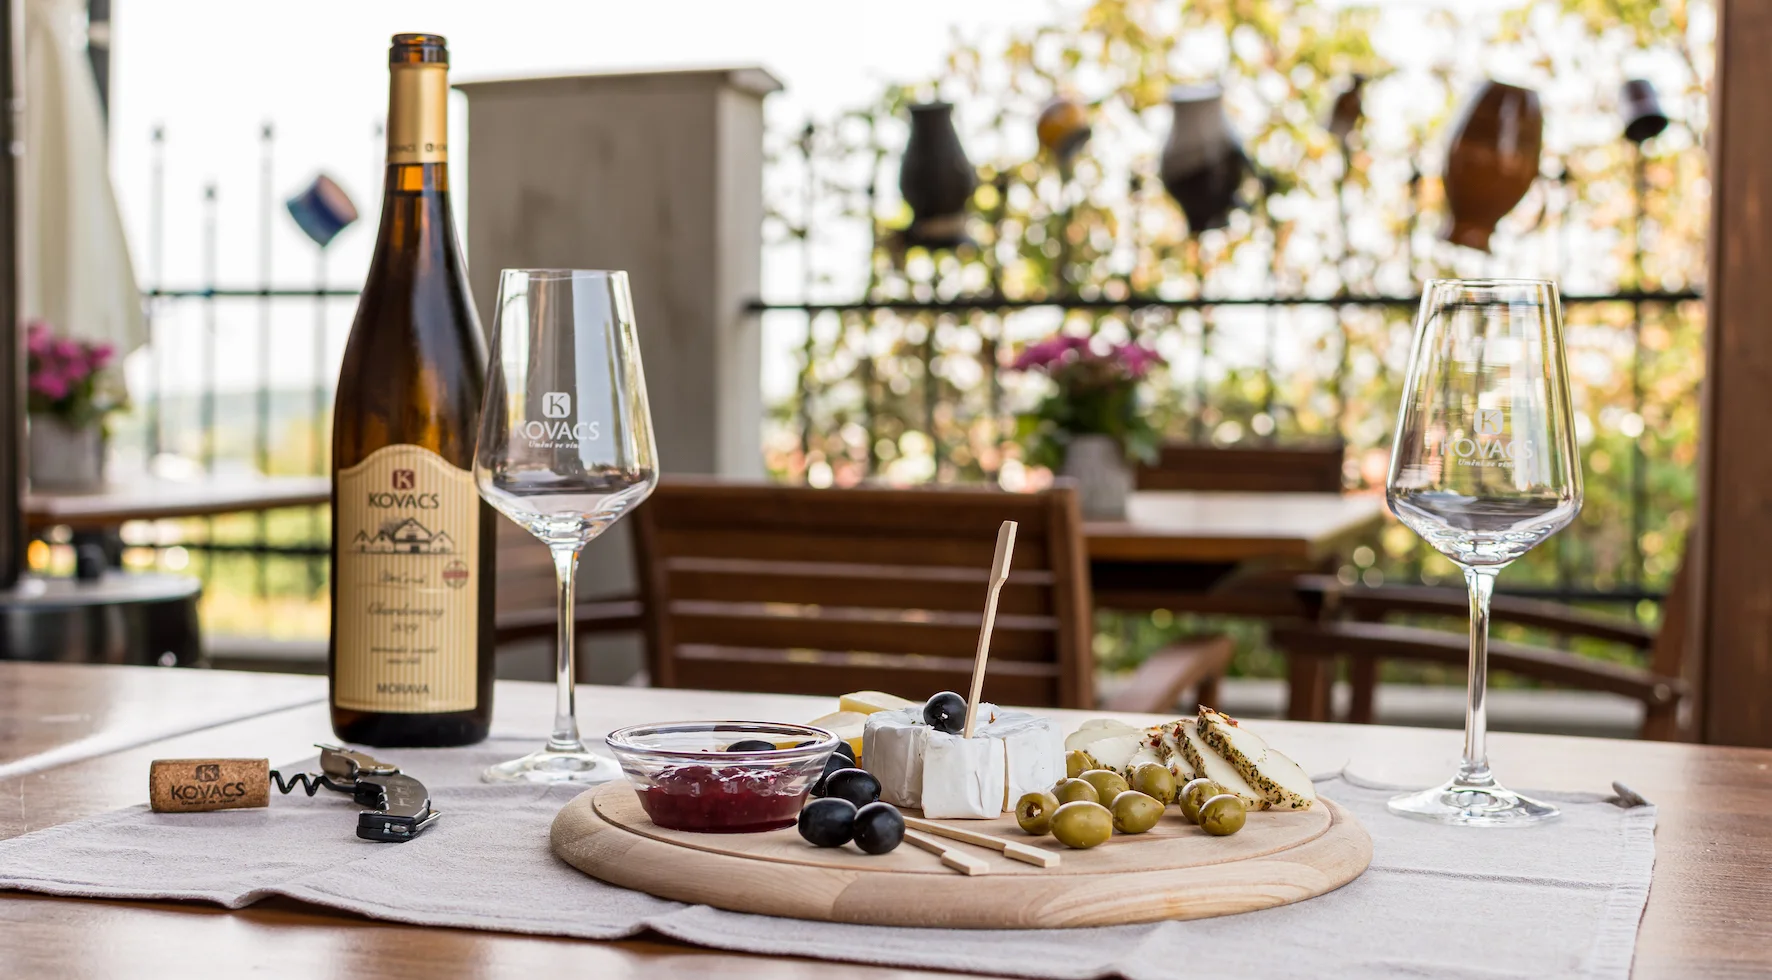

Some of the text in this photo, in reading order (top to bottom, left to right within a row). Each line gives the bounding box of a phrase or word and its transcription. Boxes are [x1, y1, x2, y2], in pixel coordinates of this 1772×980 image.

[546, 394, 568, 416] K
[513, 420, 600, 441] KOVACS
[1478, 410, 1501, 434] K
[1440, 437, 1533, 459] KOVACS
[395, 470, 414, 490] K
[368, 492, 440, 509] KOVACS
[376, 683, 430, 694] MORAVA
[198, 765, 218, 781] K
[171, 782, 246, 800] KOVACS
